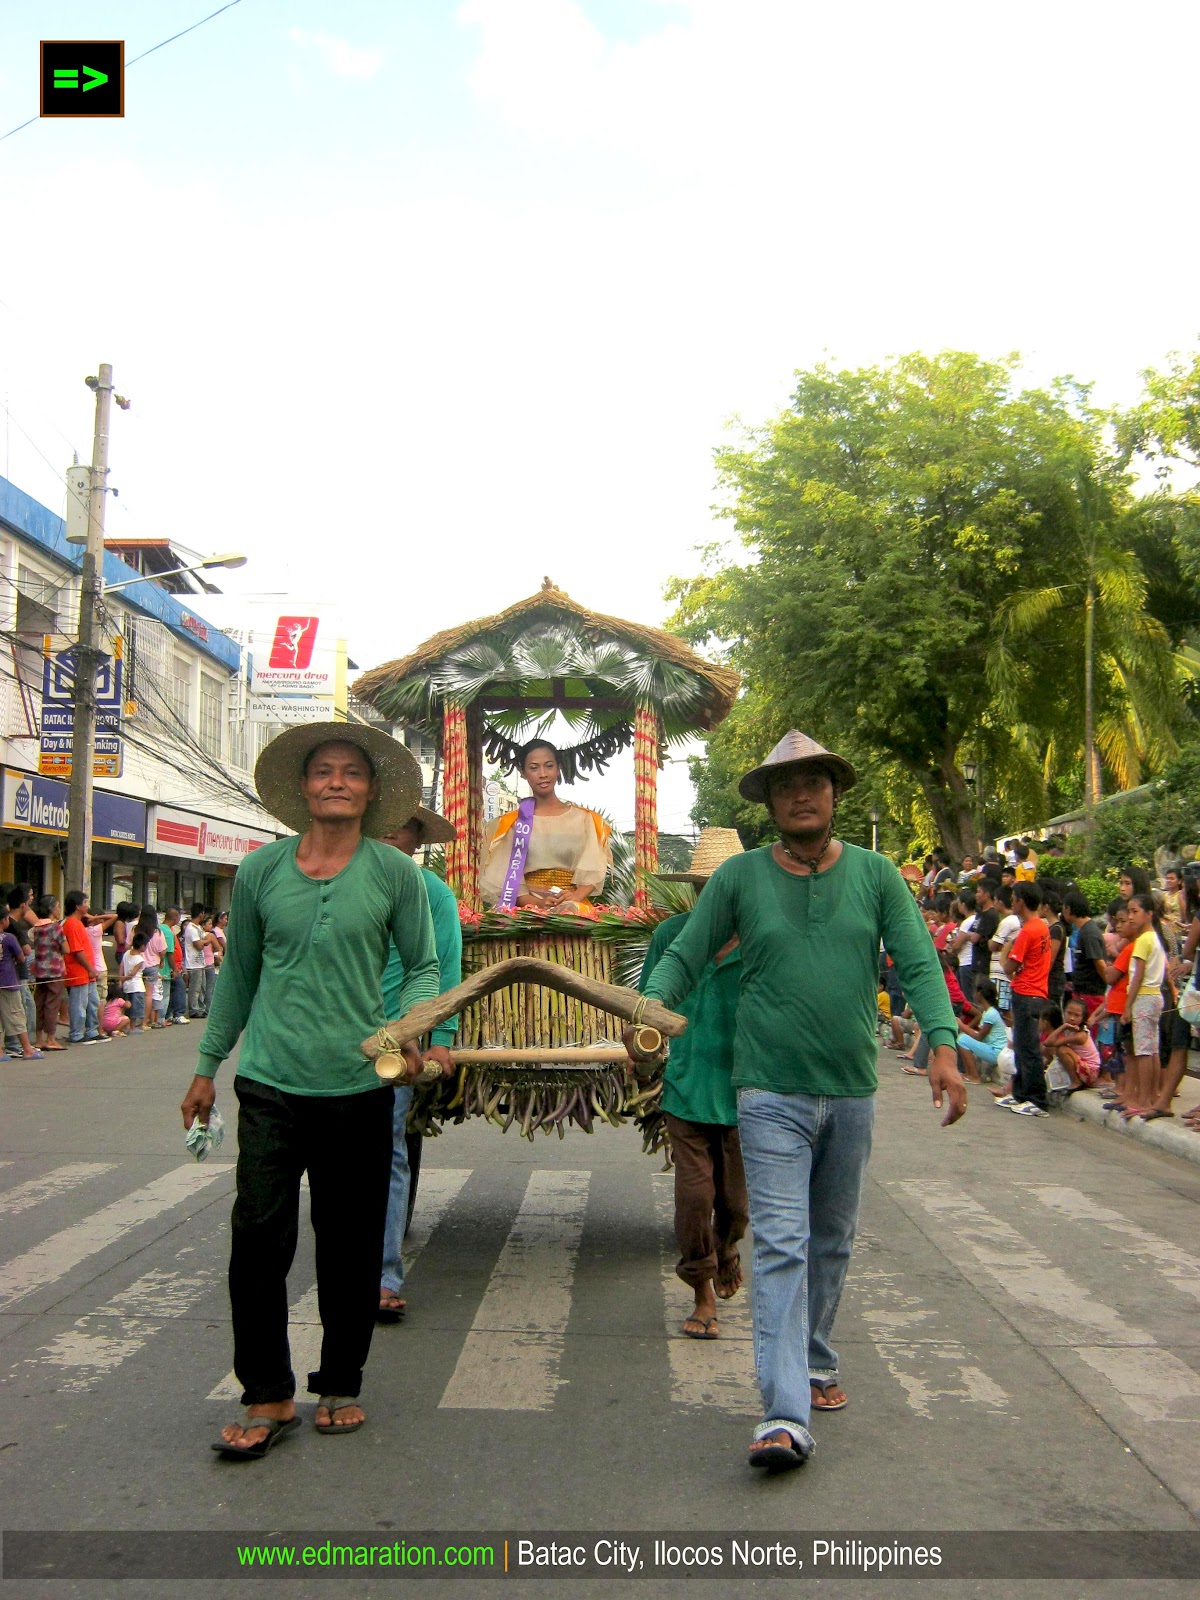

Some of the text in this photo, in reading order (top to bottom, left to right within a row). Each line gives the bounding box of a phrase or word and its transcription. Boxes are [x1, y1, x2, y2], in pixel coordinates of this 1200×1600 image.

[257, 671, 328, 681] mercury drug
[44, 714, 66, 725] BATAC
[43, 738, 58, 751] Day
[59, 739, 65, 748] &
[95, 739, 118, 753] nking
[32, 795, 70, 829] Metrob
[515, 822, 530, 835] 20
[206, 831, 248, 855] mercury drug
